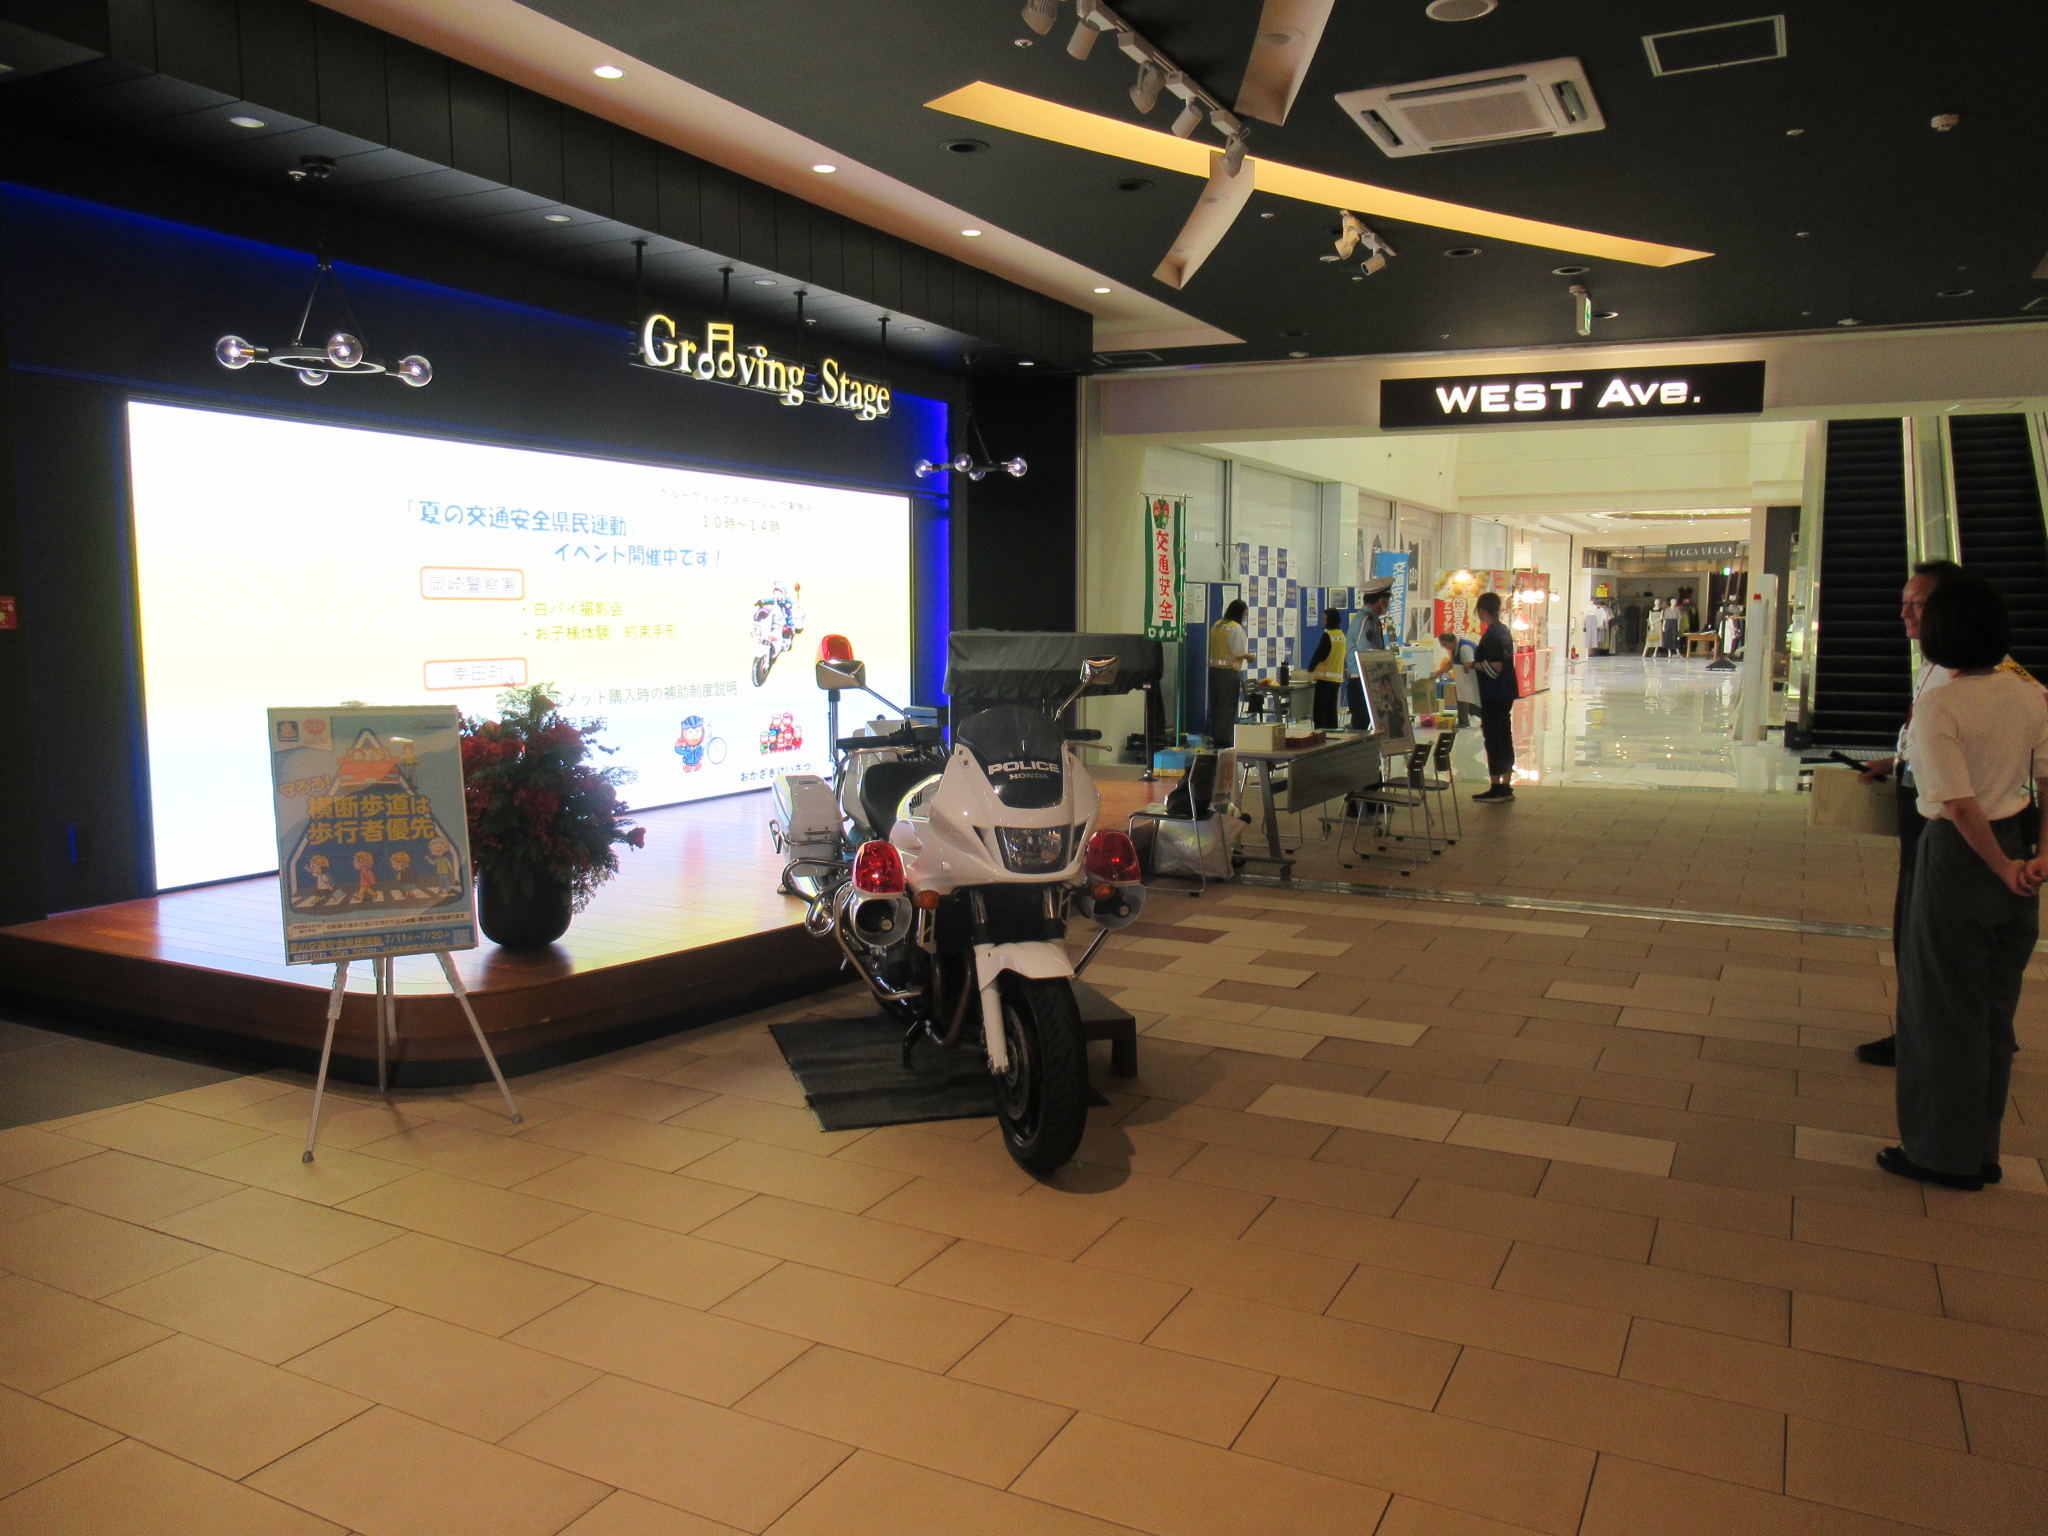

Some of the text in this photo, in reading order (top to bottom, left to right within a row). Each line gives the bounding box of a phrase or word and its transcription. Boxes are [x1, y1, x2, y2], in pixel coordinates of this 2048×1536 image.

[643, 314, 891, 421] Grooving Stage
[1436, 379, 1701, 414] WEST Ave.
[1156, 530, 1174, 620] 交通安全
[551, 681, 738, 706] ルメット購入時の補助制度説明
[988, 761, 1060, 775] POLICE
[308, 794, 431, 819] 横断歩道は
[309, 818, 436, 846] 歩行者優先
